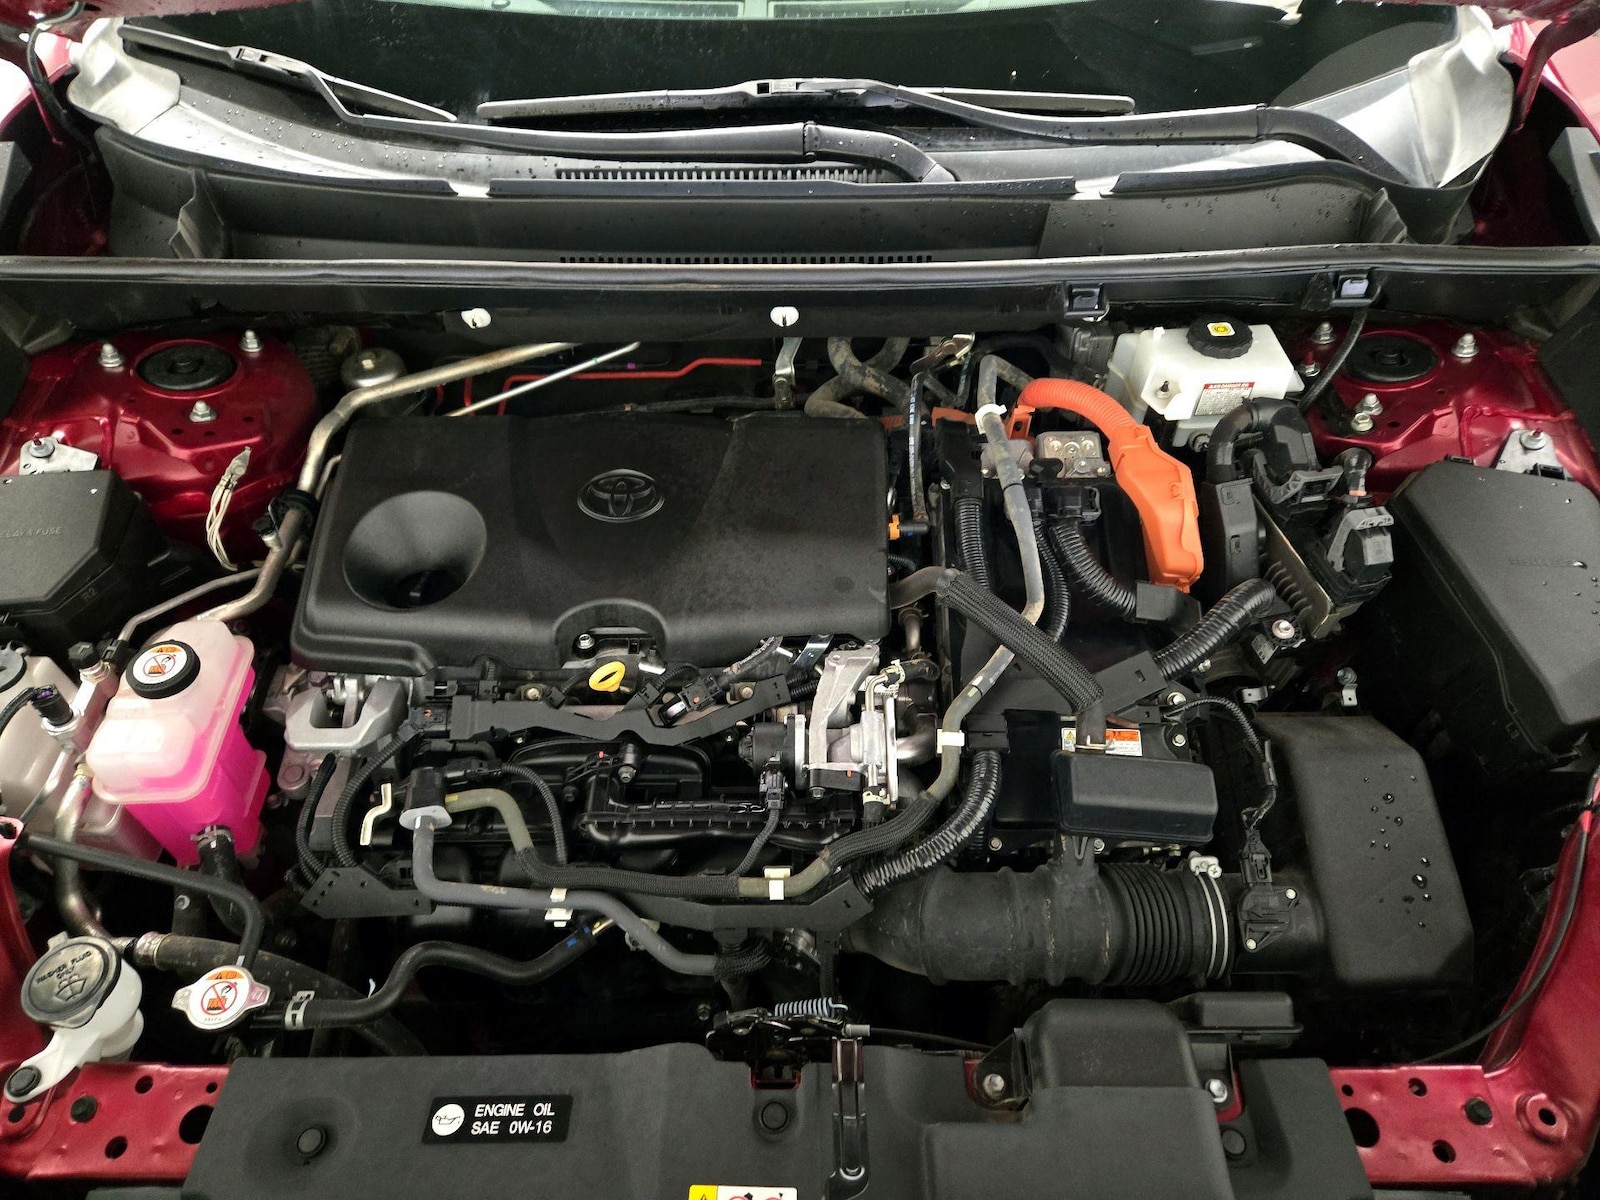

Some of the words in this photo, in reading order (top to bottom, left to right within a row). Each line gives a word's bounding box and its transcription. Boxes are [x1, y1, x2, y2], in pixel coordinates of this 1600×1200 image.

[35, 526, 62, 535] FUSE
[35, 963, 68, 984] WASHER
[70, 950, 92, 965] FLUID
[56, 964, 76, 979] ONLY
[474, 1103, 526, 1118] ENGINE
[533, 1102, 556, 1117] OIL
[470, 1121, 501, 1135] SAE
[508, 1120, 553, 1135] 0W-16
